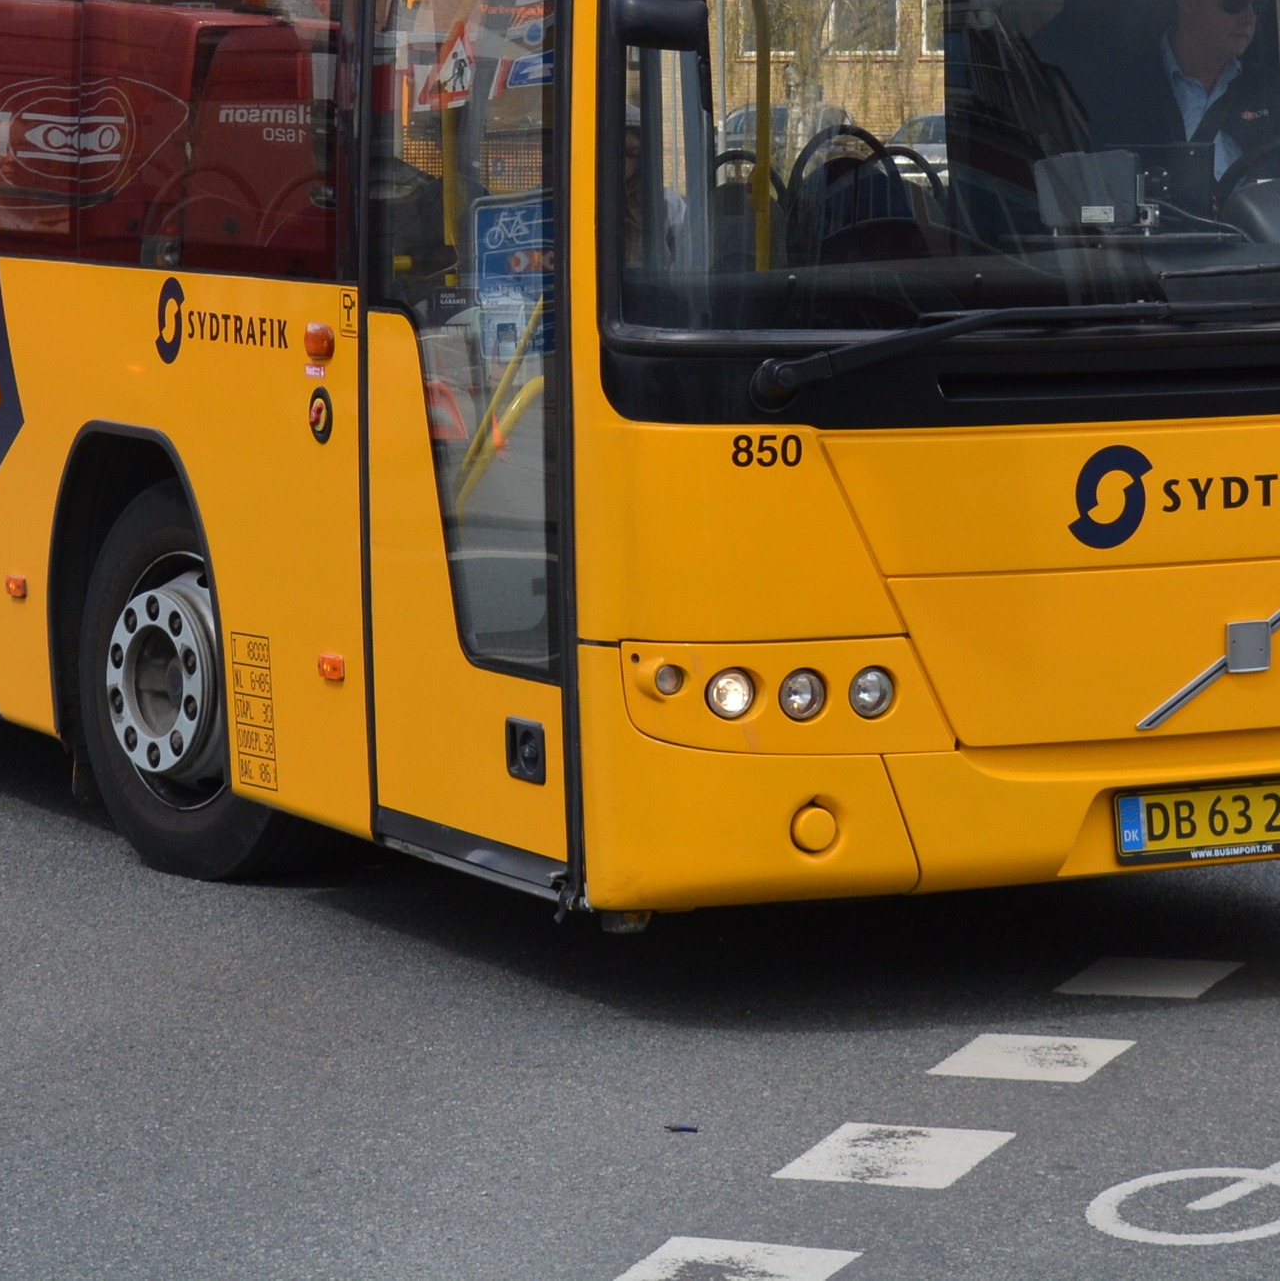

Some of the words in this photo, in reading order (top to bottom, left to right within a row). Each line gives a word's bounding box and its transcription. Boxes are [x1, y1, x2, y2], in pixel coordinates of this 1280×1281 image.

[187, 310, 289, 350] SYDTRAFIK
[731, 434, 803, 468] 850
[1124, 828, 1140, 842] DK
[1146, 799, 1197, 842] DB
[1208, 794, 1253, 837] 63
[1190, 843, 1274, 860] WWW.BUSIMPORT.DK
